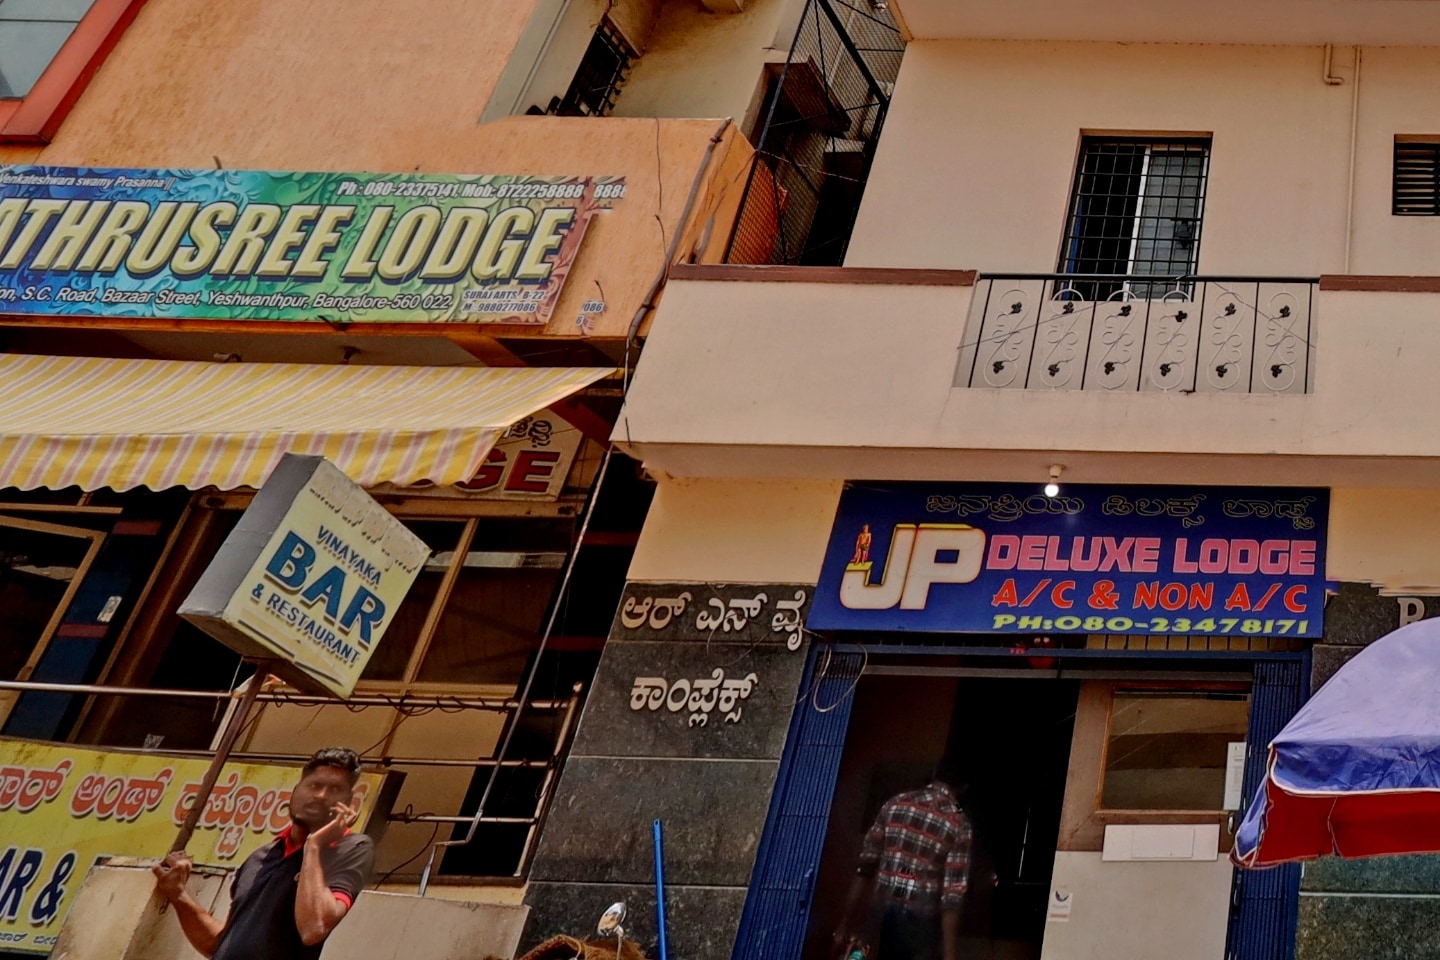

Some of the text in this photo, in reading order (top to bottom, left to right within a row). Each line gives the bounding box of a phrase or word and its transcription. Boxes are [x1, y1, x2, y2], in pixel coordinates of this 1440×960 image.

[75, 176, 115, 190] swamy
[343, 205, 577, 282] LODGE
[55, 287, 98, 304] Road,
[101, 289, 153, 304] Bazaar
[421, 295, 453, 310] 022
[265, 530, 386, 645] BAR
[317, 525, 382, 585] VINAYAKA
[839, 523, 1316, 610] JP DELUXE LODGE
[251, 583, 361, 665] & RESTAURANT
[621, 591, 692, 629] ಆರ್
[695, 592, 768, 633] ಎನ್
[991, 578, 1309, 614] A/C & NON A/C
[30, 852, 76, 924] &
